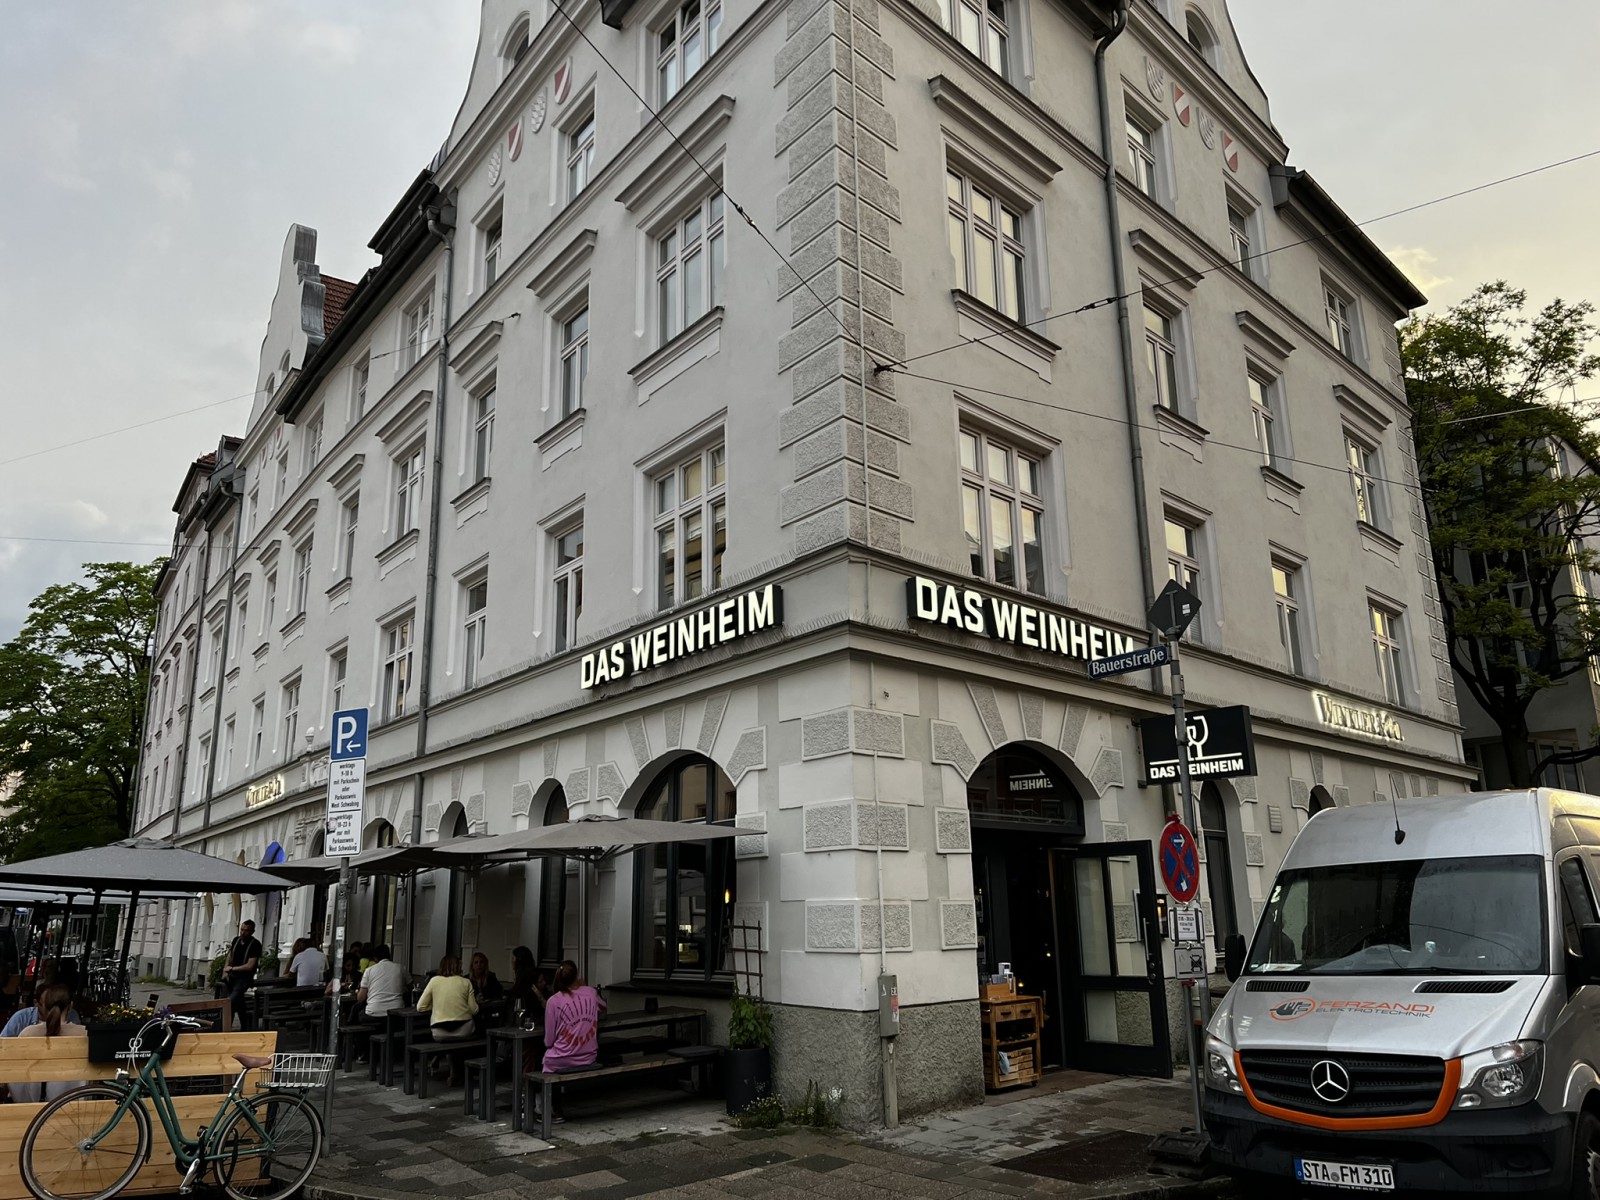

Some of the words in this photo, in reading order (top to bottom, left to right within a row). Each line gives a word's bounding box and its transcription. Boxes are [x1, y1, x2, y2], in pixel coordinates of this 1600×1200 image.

[914, 575, 984, 633] DAS
[991, 597, 1134, 661] WEINHEIM
[580, 641, 625, 689] DAS
[630, 584, 775, 672] WEINHEIM
[1092, 648, 1165, 675] Bauerstraße
[336, 716, 357, 754] P
[1150, 766, 1176, 779] DAS
[1177, 758, 1244, 775] EINHEIM
[1315, 1007, 1431, 1018] ELEKTROTECHNIK
[1319, 1000, 1435, 1013] FERZANDI
[1303, 1162, 1330, 1181] STA
[1340, 1165, 1360, 1184] FM
[1362, 1167, 1392, 1186] 310
